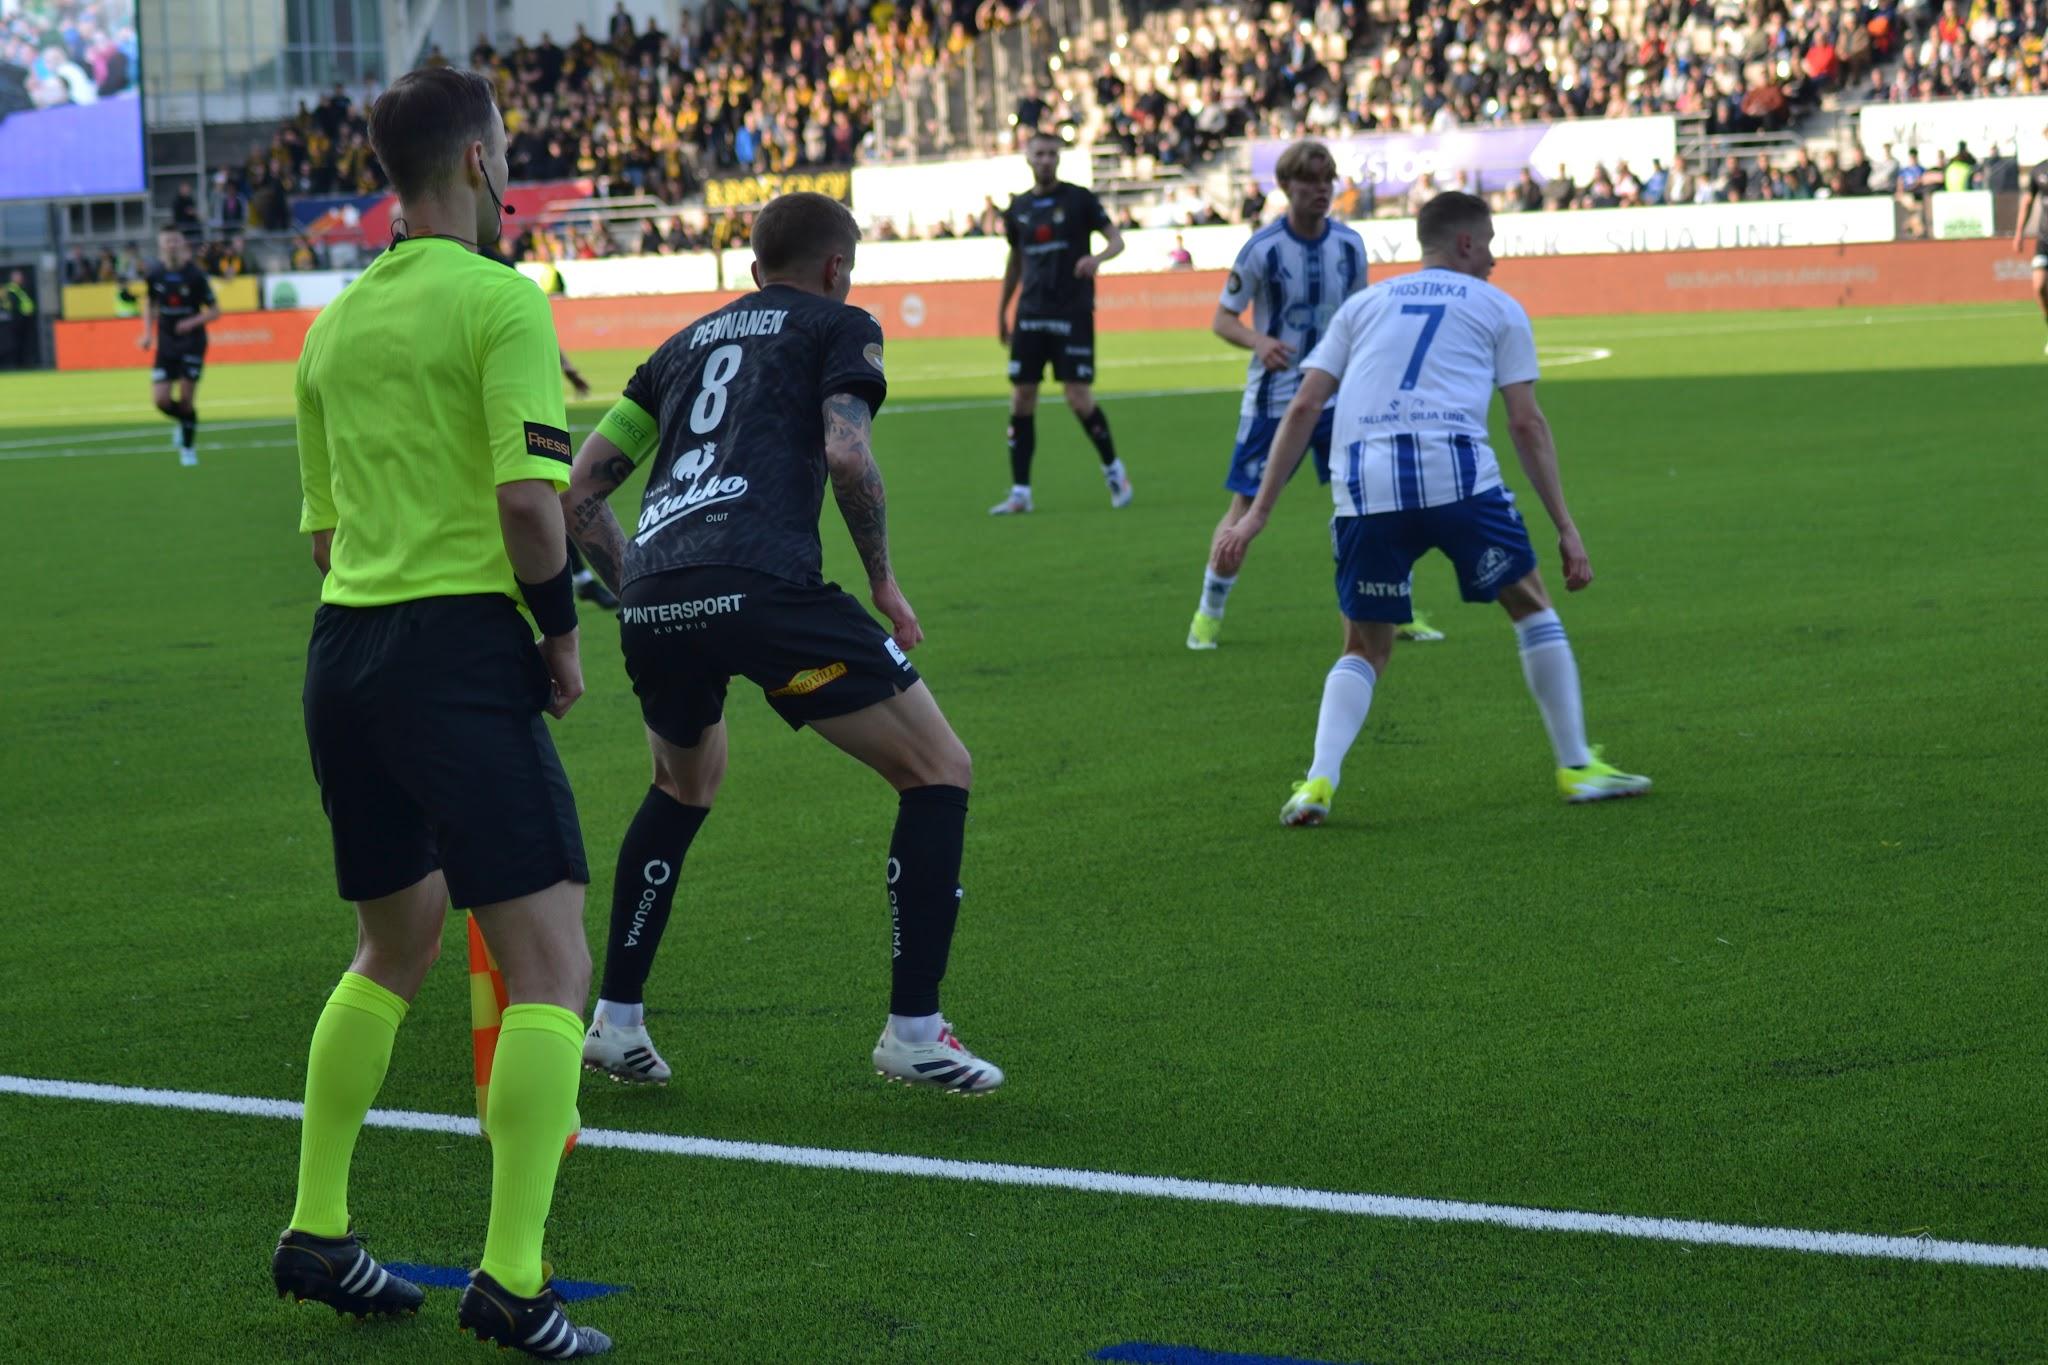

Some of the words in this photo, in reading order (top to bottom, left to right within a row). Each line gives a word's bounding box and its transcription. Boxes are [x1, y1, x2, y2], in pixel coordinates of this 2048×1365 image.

[1388, 281, 1467, 299] HOSTIKKA
[690, 309, 789, 350] PENNANEN
[1399, 304, 1446, 390] 7
[689, 344, 743, 435] 8
[611, 411, 646, 441] RESPECT
[1358, 414, 1400, 424] TALLINK
[1410, 411, 1439, 422] SILJA
[1443, 411, 1466, 422] LINE
[528, 431, 571, 457] FRESSI
[636, 475, 748, 542] Kukko
[706, 513, 728, 523] OLUT
[630, 594, 743, 624] INTERSPORT
[624, 889, 656, 947] OSUMA
[890, 890, 901, 958] OSUMA
